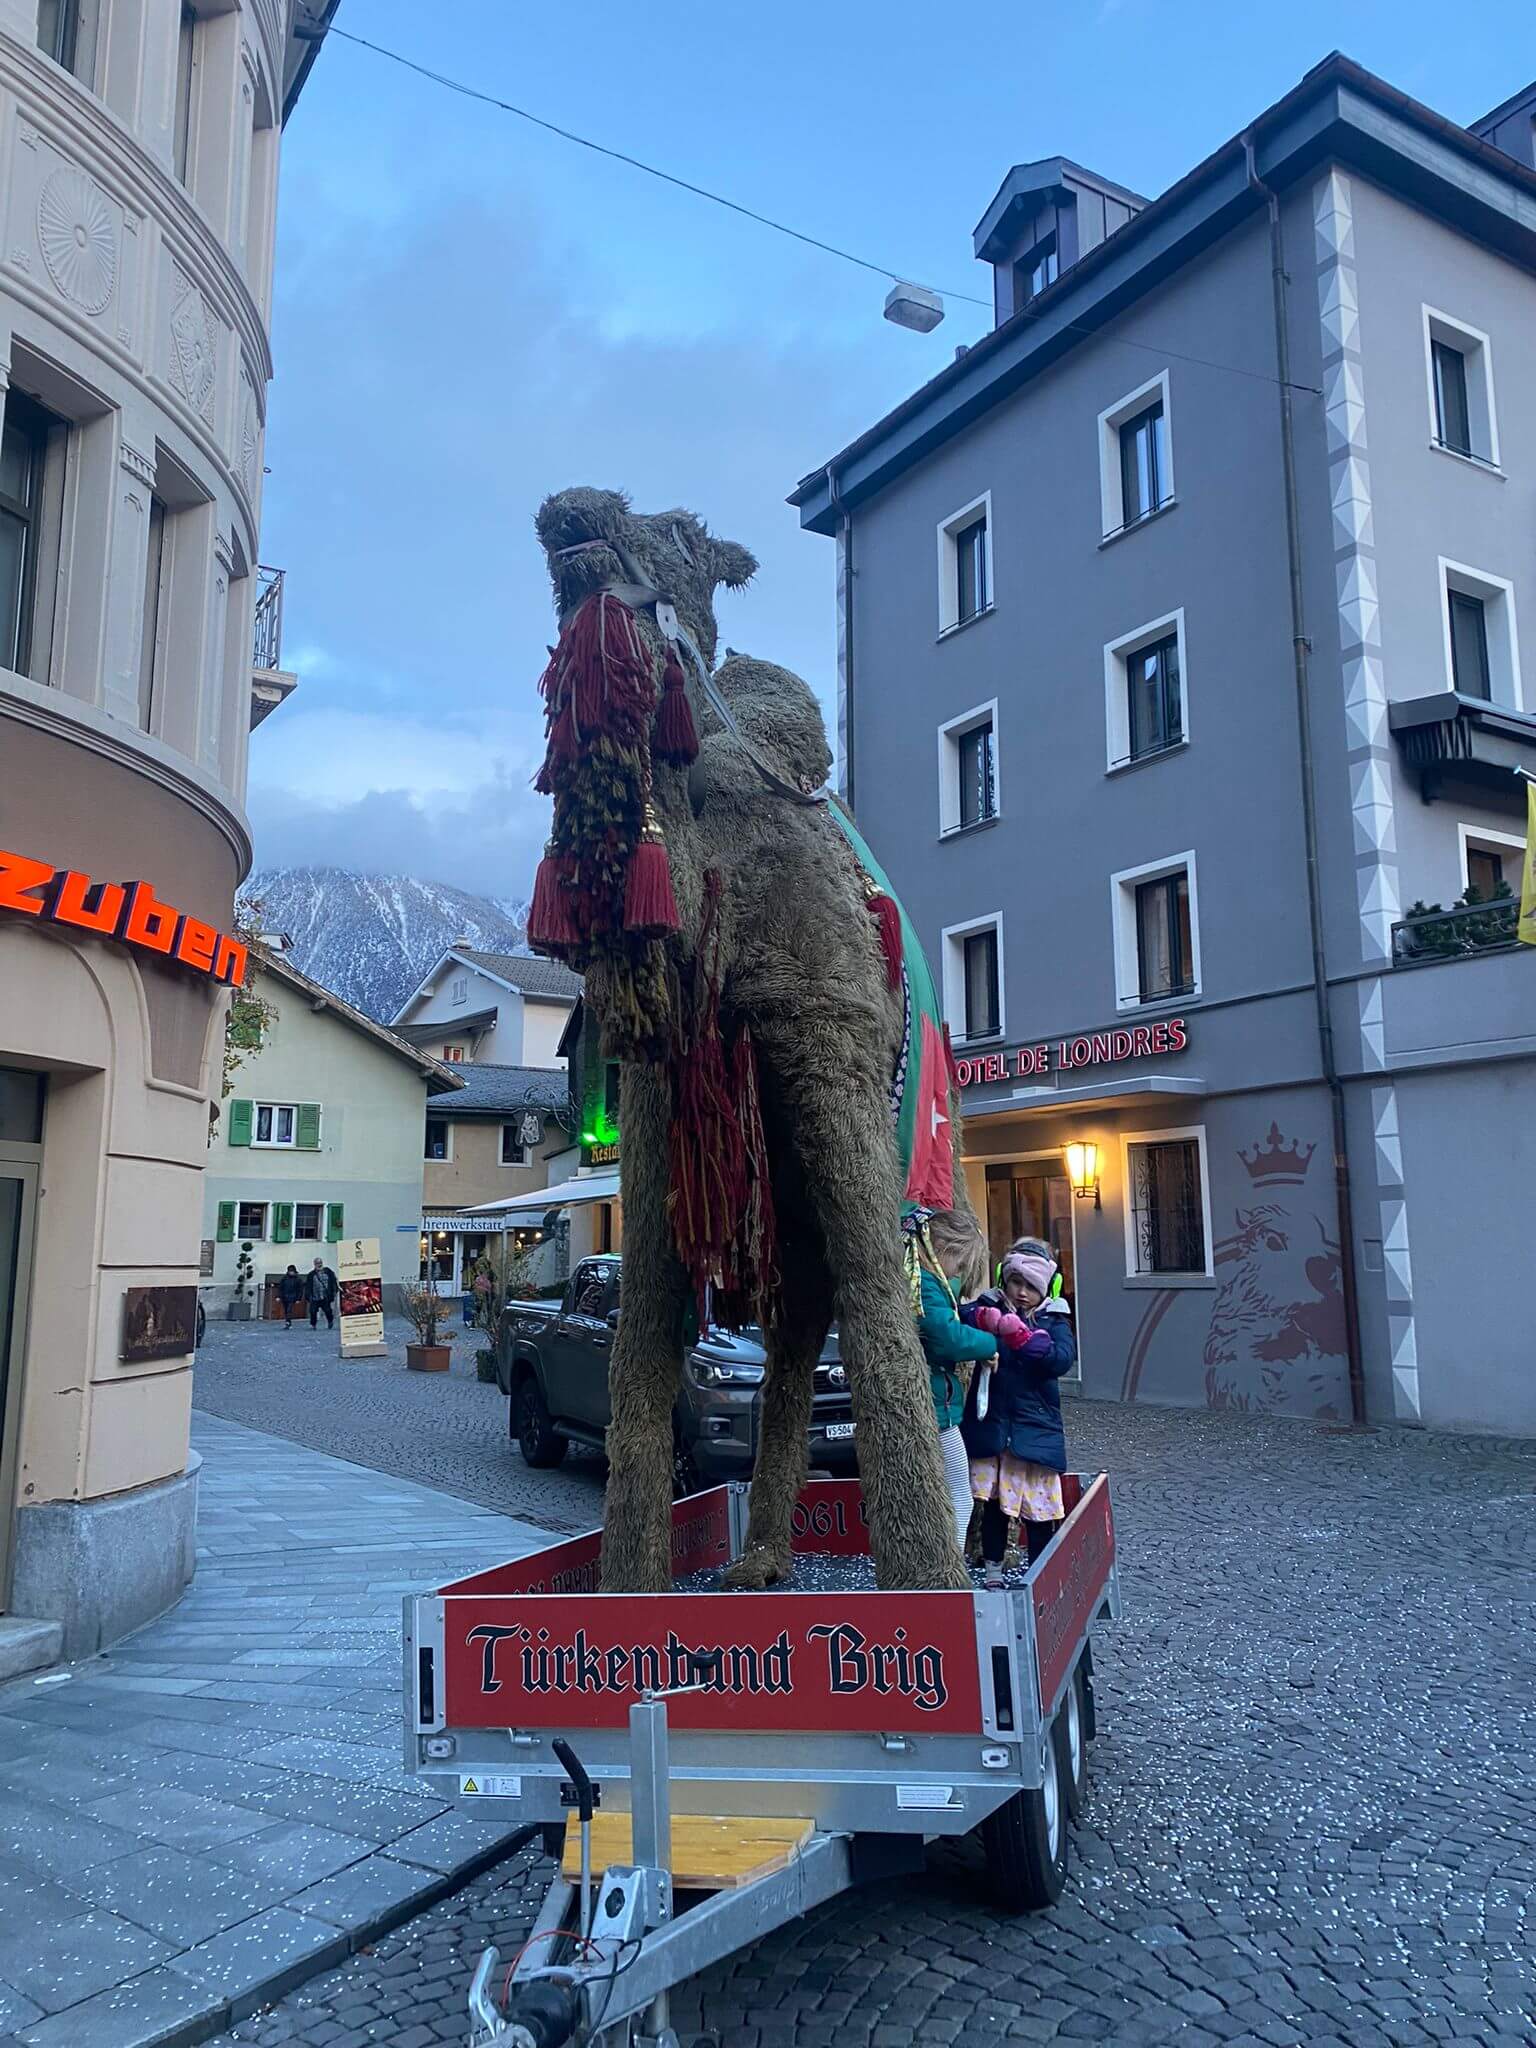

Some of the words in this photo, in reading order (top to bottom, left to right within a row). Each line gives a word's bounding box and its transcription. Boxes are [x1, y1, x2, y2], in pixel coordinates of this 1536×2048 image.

[954, 1053, 1010, 1087] OTEL
[1017, 1046, 1049, 1076] DE
[1058, 1018, 1187, 1070] LONDRES
[806, 1622, 949, 1712] Brig
